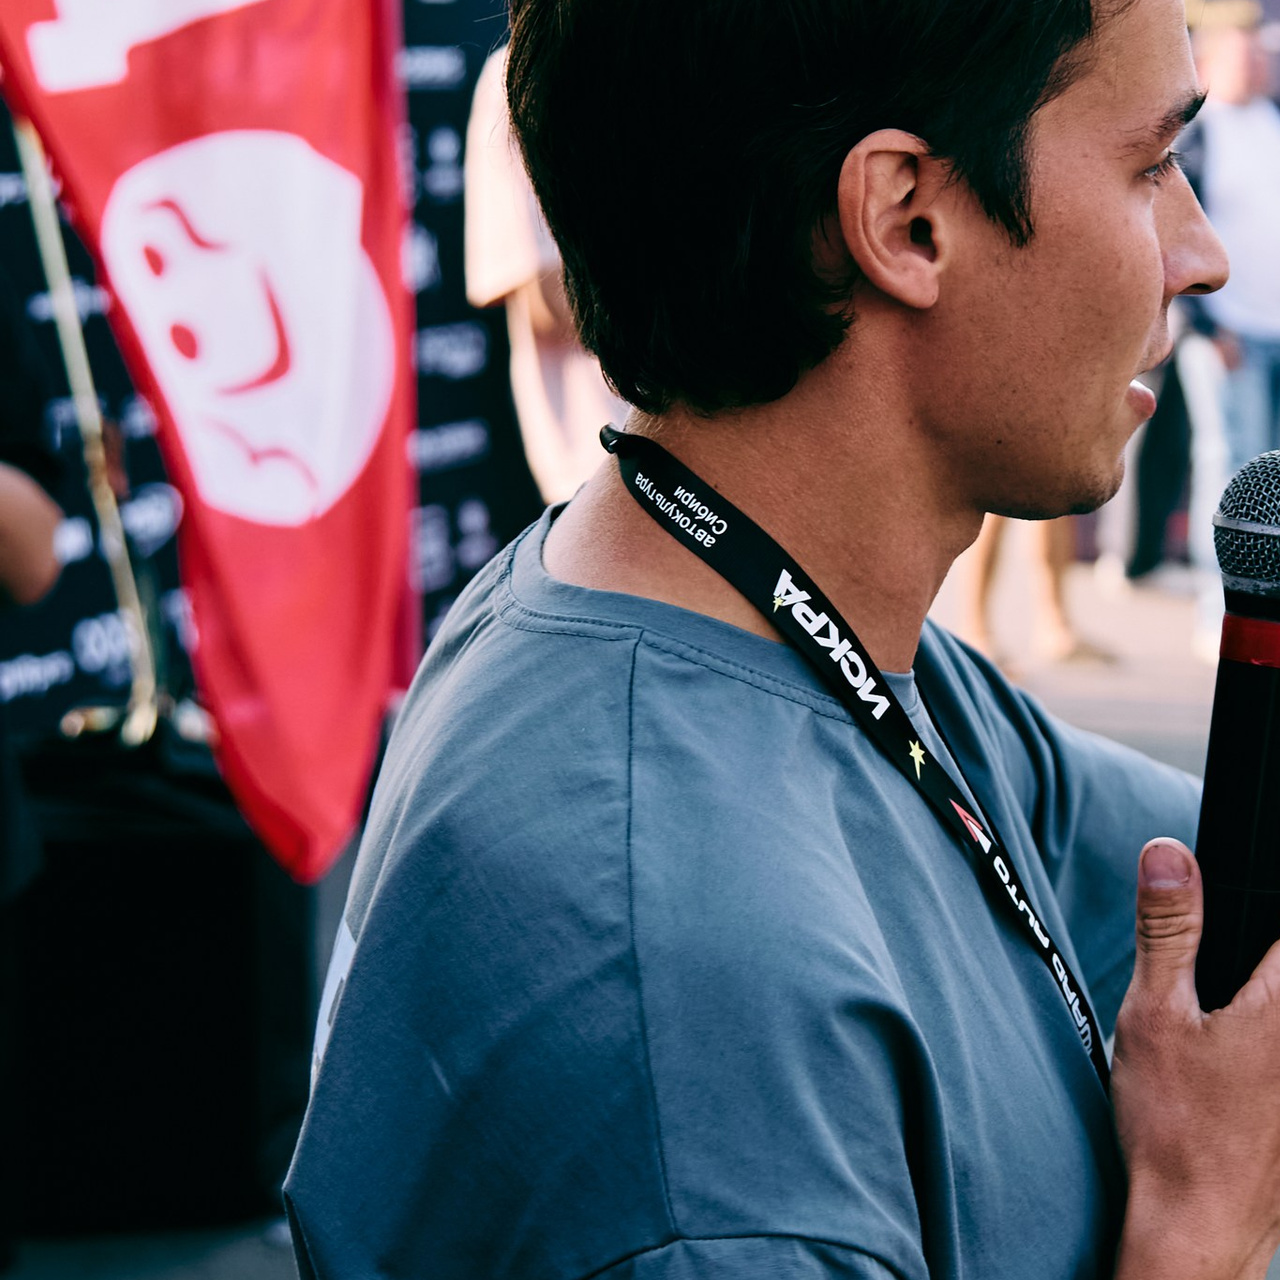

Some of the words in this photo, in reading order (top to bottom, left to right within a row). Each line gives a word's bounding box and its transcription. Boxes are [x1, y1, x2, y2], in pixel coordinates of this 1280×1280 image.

[634, 472, 717, 548] автокультура
[673, 485, 728, 535] Сибири
[772, 568, 891, 720] ИСКРА
[993, 855, 1050, 949] AUTO
[1052, 952, 1093, 1057] WARD
